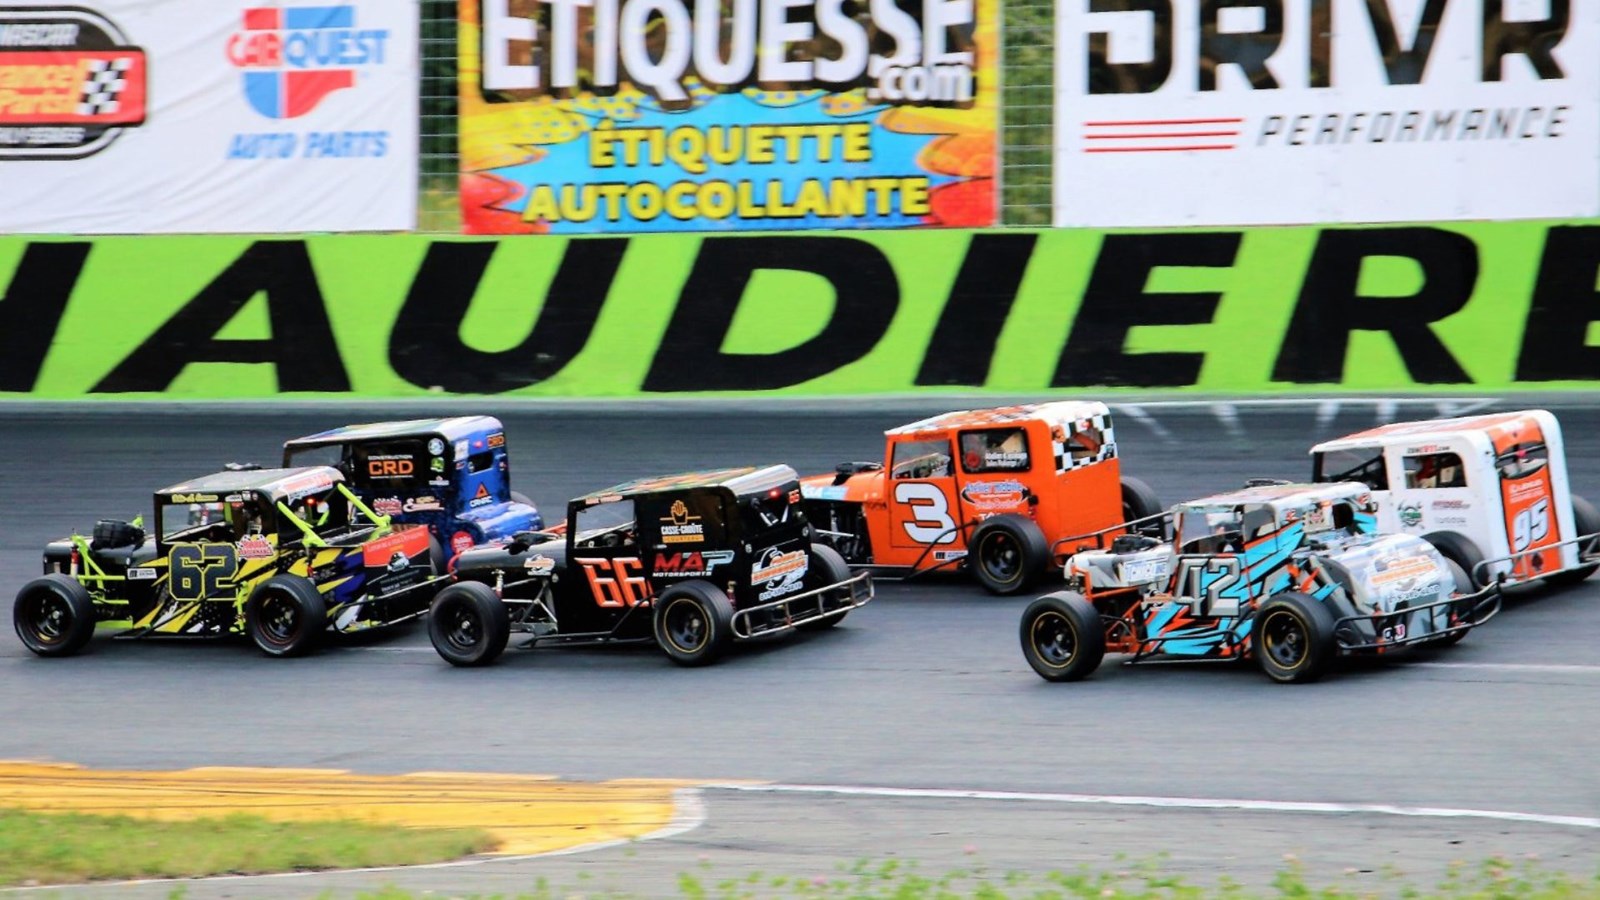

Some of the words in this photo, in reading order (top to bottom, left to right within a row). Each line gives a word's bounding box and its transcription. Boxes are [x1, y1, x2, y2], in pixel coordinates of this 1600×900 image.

[225, 29, 390, 68] CARQUEST
[867, 63, 971, 101] .com
[225, 132, 298, 160] AUTO
[303, 130, 390, 158] PARTS
[588, 119, 872, 174] ÉTIQUETTE
[1258, 105, 1572, 147] PERFORMANCE
[522, 177, 931, 222] AUTOCOLLANTE
[368, 460, 414, 475] CRD
[894, 482, 957, 544] 3
[1512, 496, 1550, 553] 95
[168, 541, 239, 602] 62
[574, 557, 651, 608] 66
[653, 550, 735, 575] MAP
[1172, 557, 1241, 617] 42
